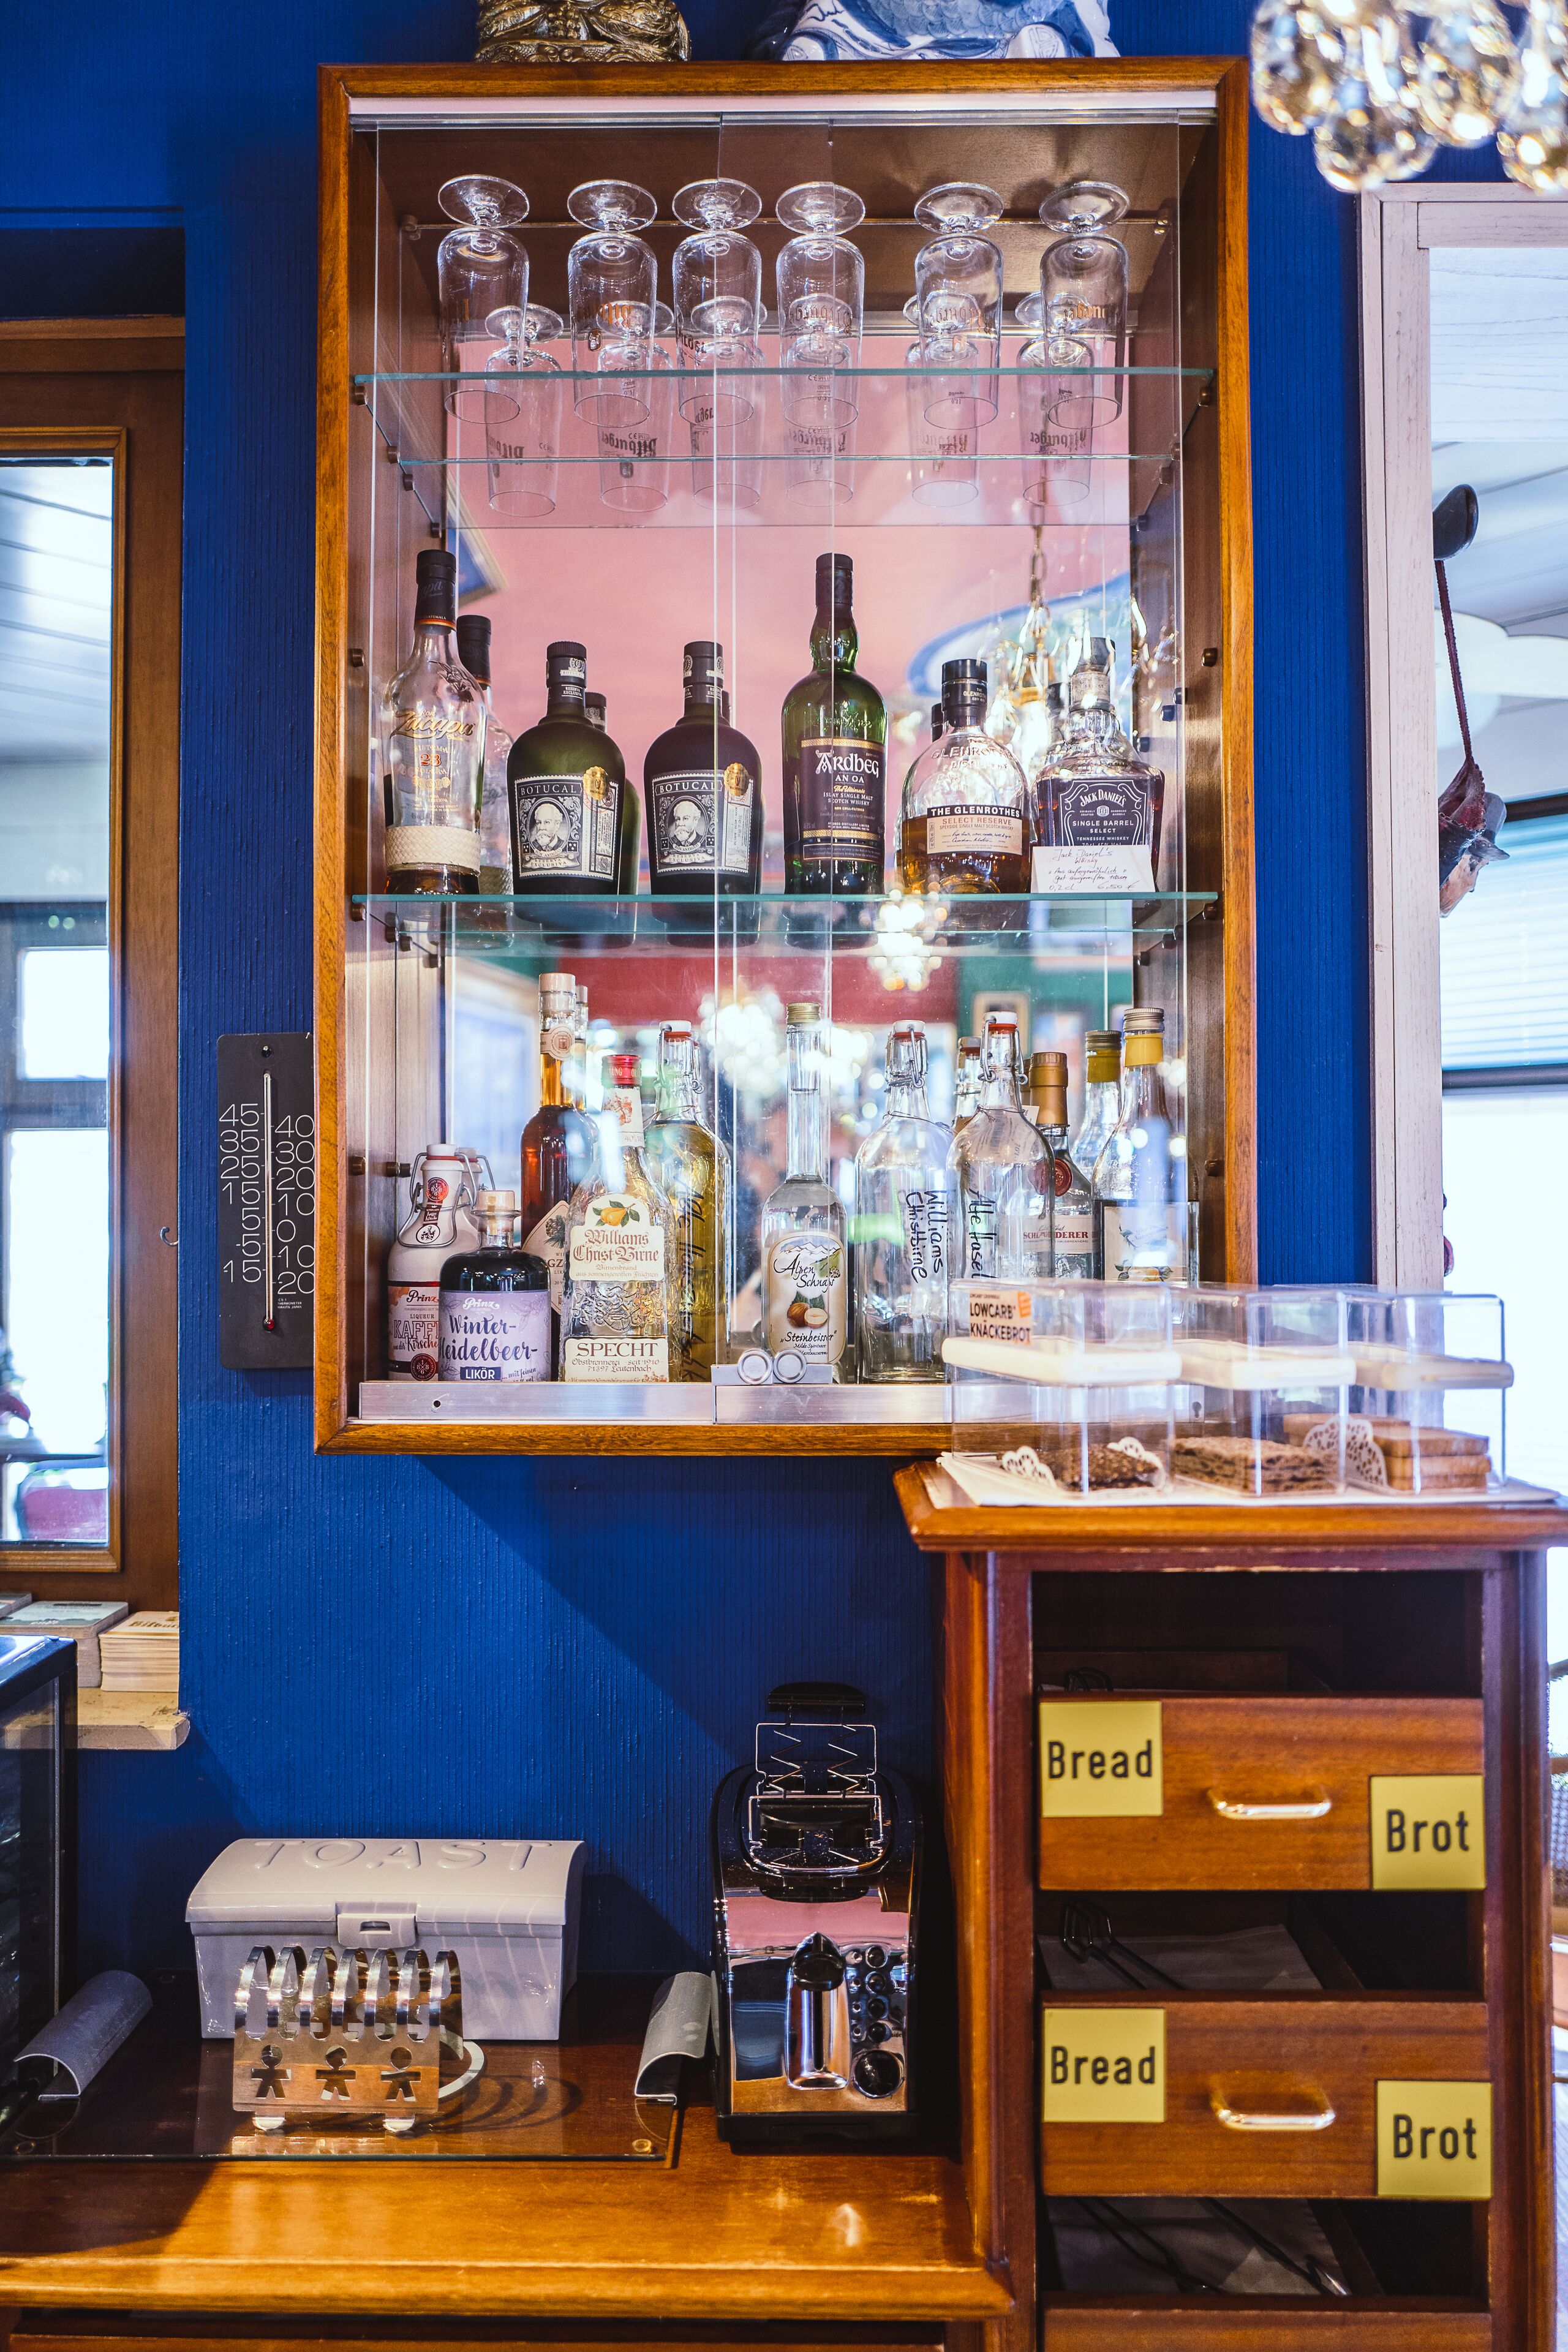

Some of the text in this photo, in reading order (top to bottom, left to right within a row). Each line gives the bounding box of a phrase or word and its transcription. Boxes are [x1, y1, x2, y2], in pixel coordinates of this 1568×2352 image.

[390, 709, 475, 740] Zacapa
[421, 753, 441, 766] 23
[521, 784, 577, 796] BOTUCAL
[660, 782, 715, 793] BOTUCAL
[851, 775, 864, 783] OA
[1080, 789, 1126, 807] JACK DANIEL'S
[931, 806, 1020, 818] THE GLENROTHES
[1052, 849, 1072, 861] Jack
[219, 1104, 260, 1126] 45
[275, 1115, 314, 1137] 40
[220, 1129, 260, 1153] 35
[276, 1141, 315, 1164] 30
[221, 1155, 260, 1178] 25
[276, 1167, 315, 1190] 20
[222, 1182, 260, 1205] 15
[278, 1193, 315, 1216] 10
[242, 1207, 261, 1231] 5
[277, 1219, 296, 1242] 0
[584, 1229, 649, 1247] Williams
[924, 1190, 948, 1274] Williams
[968, 1188, 1000, 1279] Alte Hasel
[774, 1253, 815, 1280] Alpen
[796, 1273, 835, 1293] Schnaps
[406, 1290, 439, 1303] Prinz
[462, 1297, 500, 1310] Prinz
[449, 1314, 516, 1335] Winter-
[971, 1319, 1031, 1342] KNÄCKEBROT
[576, 1343, 658, 1357] SPECHT
[466, 1367, 496, 1379] LIKÖR
[1047, 1740, 1153, 1779] Bread
[1387, 1809, 1470, 1853] Brot
[253, 1839, 552, 1871] TOAST
[1051, 2046, 1156, 2085] Bread
[1393, 2114, 1477, 2160] Brot
